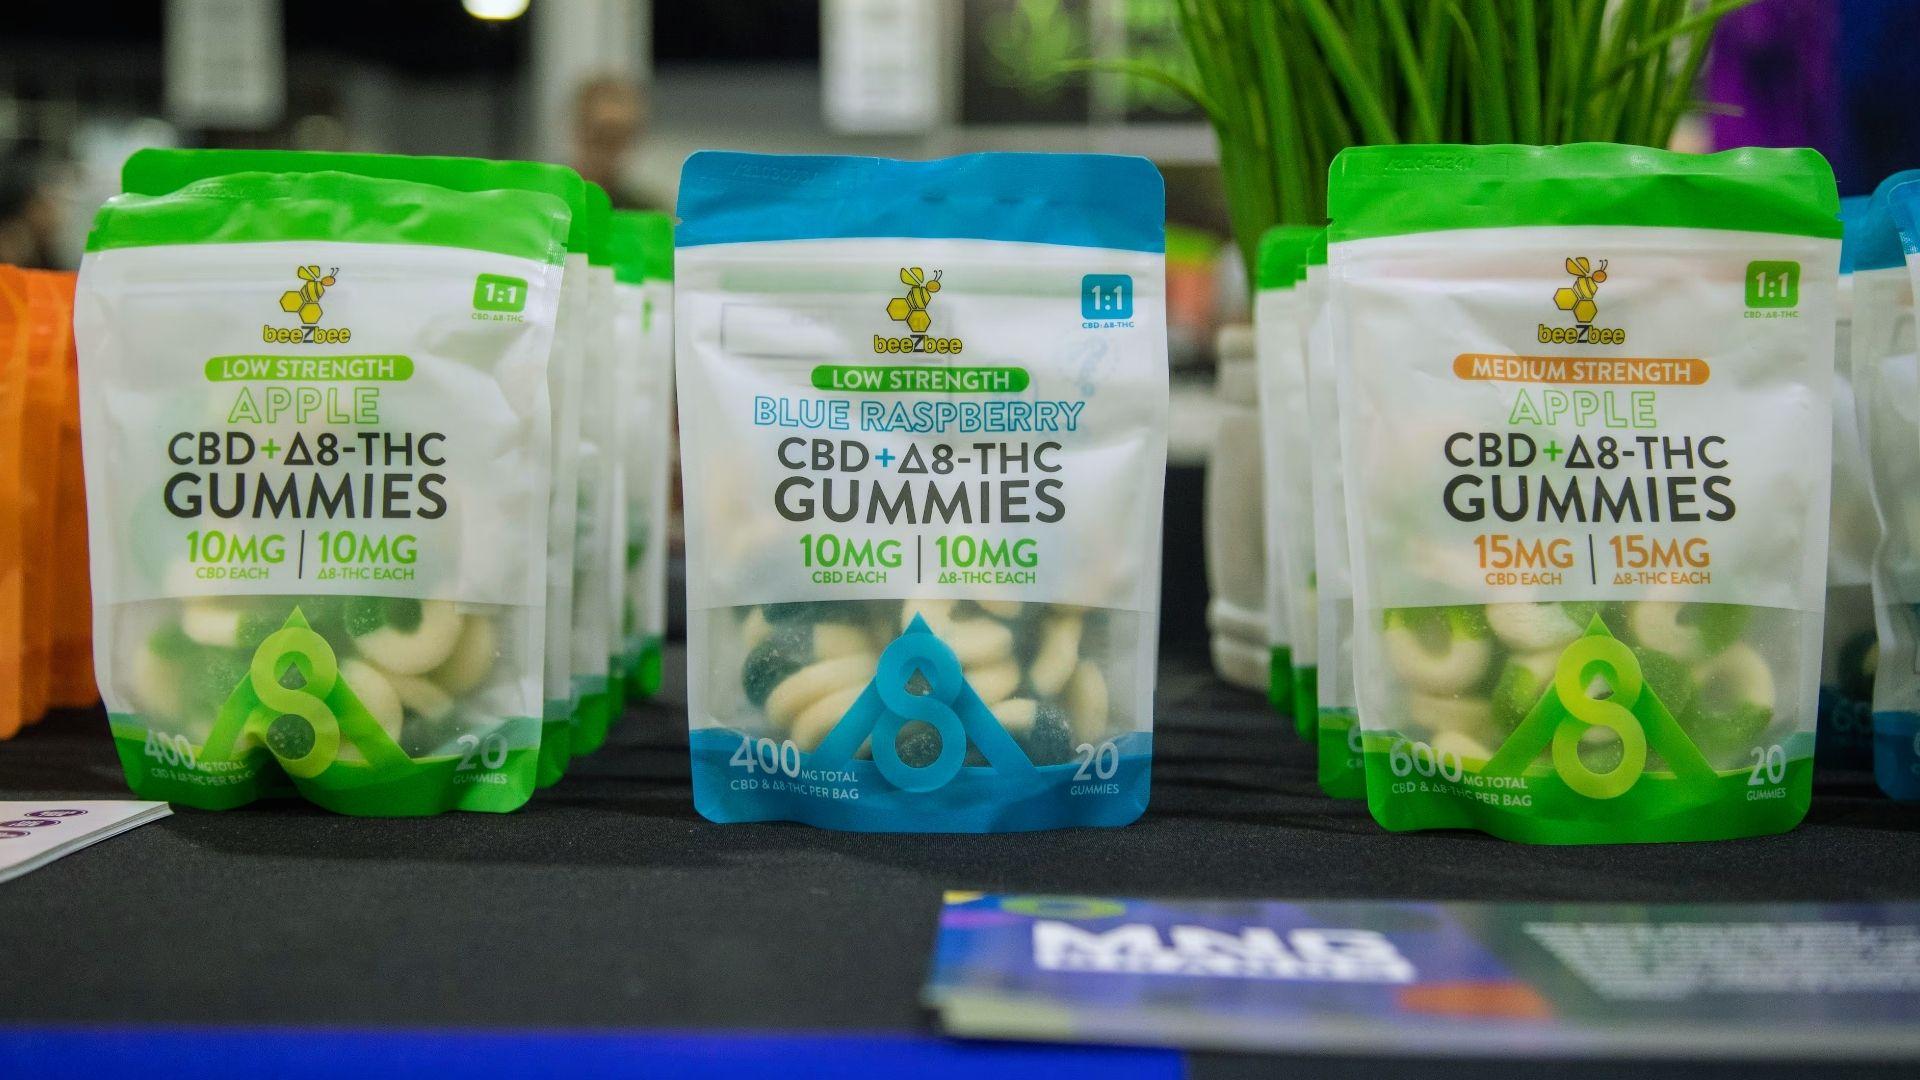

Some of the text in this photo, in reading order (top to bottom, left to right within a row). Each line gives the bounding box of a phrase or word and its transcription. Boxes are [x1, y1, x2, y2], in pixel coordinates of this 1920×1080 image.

[485, 283, 517, 304] 1:1
[1091, 285, 1123, 311] 1:1
[1756, 272, 1789, 298] 1:1
[223, 359, 395, 379] LOW STRENGTH
[833, 370, 1010, 390] LOW STRENGTH
[1472, 357, 1691, 383] MEDIUM STRENGTH
[227, 387, 380, 425] APPLE
[754, 396, 1085, 433] BLUE RASPBERRY
[1509, 389, 1657, 429] APPLE
[163, 472, 448, 521] GUMMIES
[774, 478, 1066, 525] GUMMIES
[1443, 475, 1736, 523] GUMMIES
[186, 530, 286, 565] 10MG
[316, 530, 418, 565] 10MG
[800, 533, 902, 568] 10MG
[935, 535, 1038, 568] 10MG
[1473, 534, 1574, 569] 15MG
[1609, 535, 1711, 569] 15MG
[196, 567, 269, 580] CBD EACH
[374, 567, 415, 580] EACH
[812, 571, 887, 584] CBD EACH
[996, 571, 1036, 584] EACH
[1485, 572, 1562, 585] CBD EACH
[1671, 571, 1711, 584] EACH
[145, 729, 196, 771] 400
[456, 734, 508, 771] 20
[729, 736, 858, 782] 400 MG TOTAL
[1072, 742, 1119, 781] 20
[1390, 738, 1529, 789] 600 MG TOTAL
[1747, 744, 1786, 786] 20
[453, 772, 508, 785] GUMMIES
[730, 779, 758, 791] CBD
[762, 780, 770, 790] &
[810, 786, 829, 798] PER
[832, 788, 859, 799] BAG
[1070, 783, 1119, 797] GUMMIES
[1392, 782, 1416, 794] CBD
[1420, 782, 1429, 792] &
[1475, 793, 1499, 805] PER
[1503, 794, 1532, 807] BAG
[1747, 787, 1786, 801] GUMMIES
